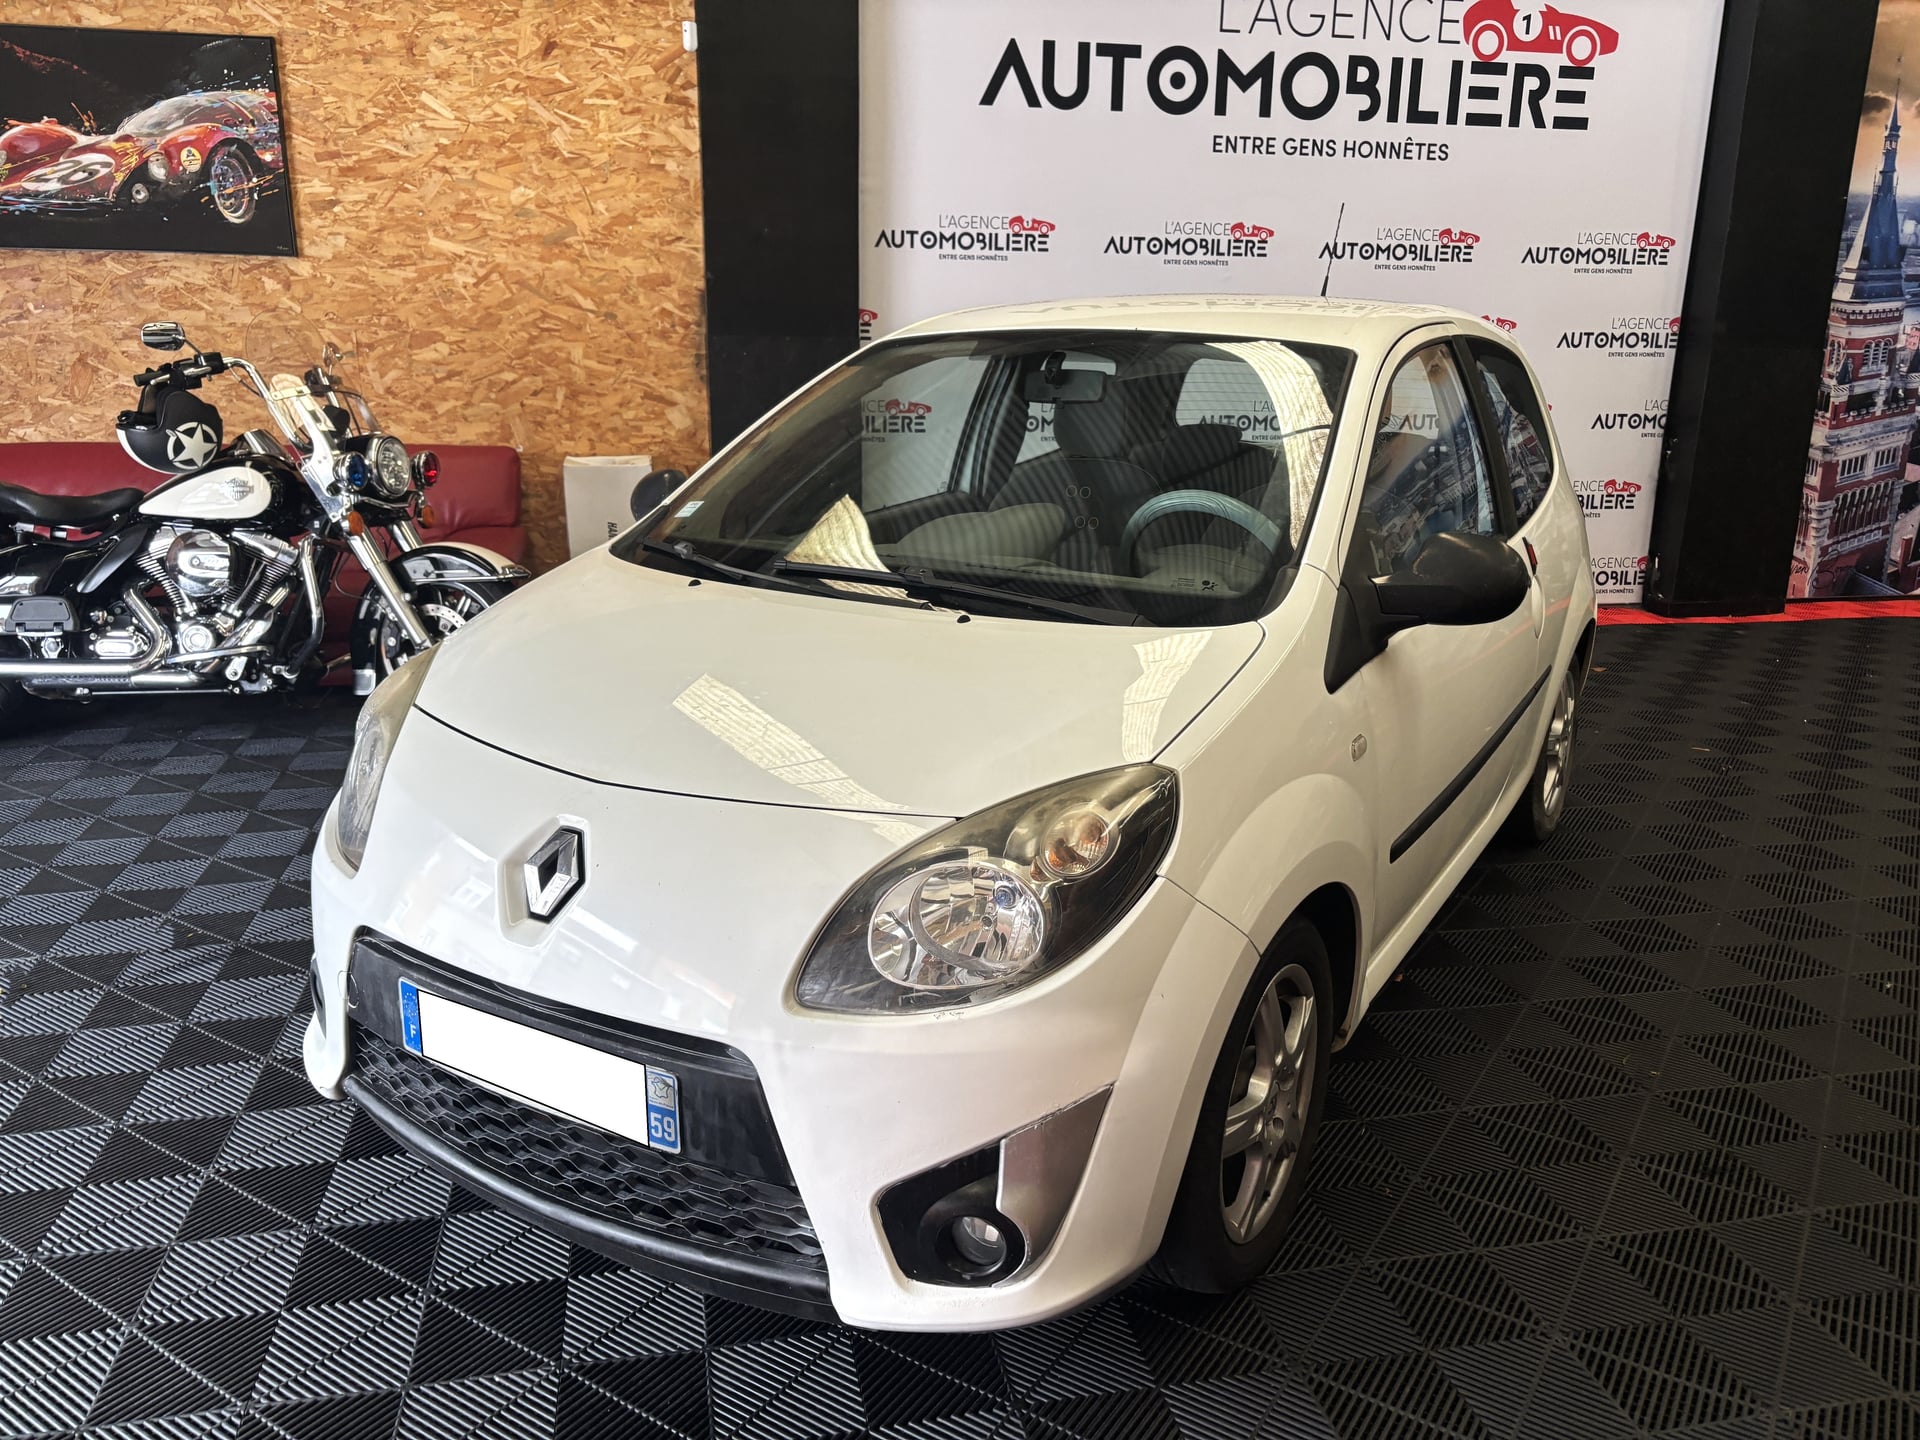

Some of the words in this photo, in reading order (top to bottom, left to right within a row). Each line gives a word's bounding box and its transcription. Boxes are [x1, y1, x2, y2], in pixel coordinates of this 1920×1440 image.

[1219, 0, 1461, 45] LAGENCE
[1521, 13, 1533, 36] 1
[1212, 135, 1277, 155] ENTRE
[1282, 137, 1337, 158] GENS
[1343, 137, 1450, 162] HONNÊTES
[938, 214, 1009, 230] L'AGENCE
[1165, 221, 1231, 236] L'AGENCE
[1376, 227, 1440, 242] L'AGENCE
[1577, 232, 1638, 245] L'AGENCE
[1611, 317, 1670, 330] L'AGENCE
[409, 1023, 417, 1039] F
[650, 1111, 676, 1142] 59
